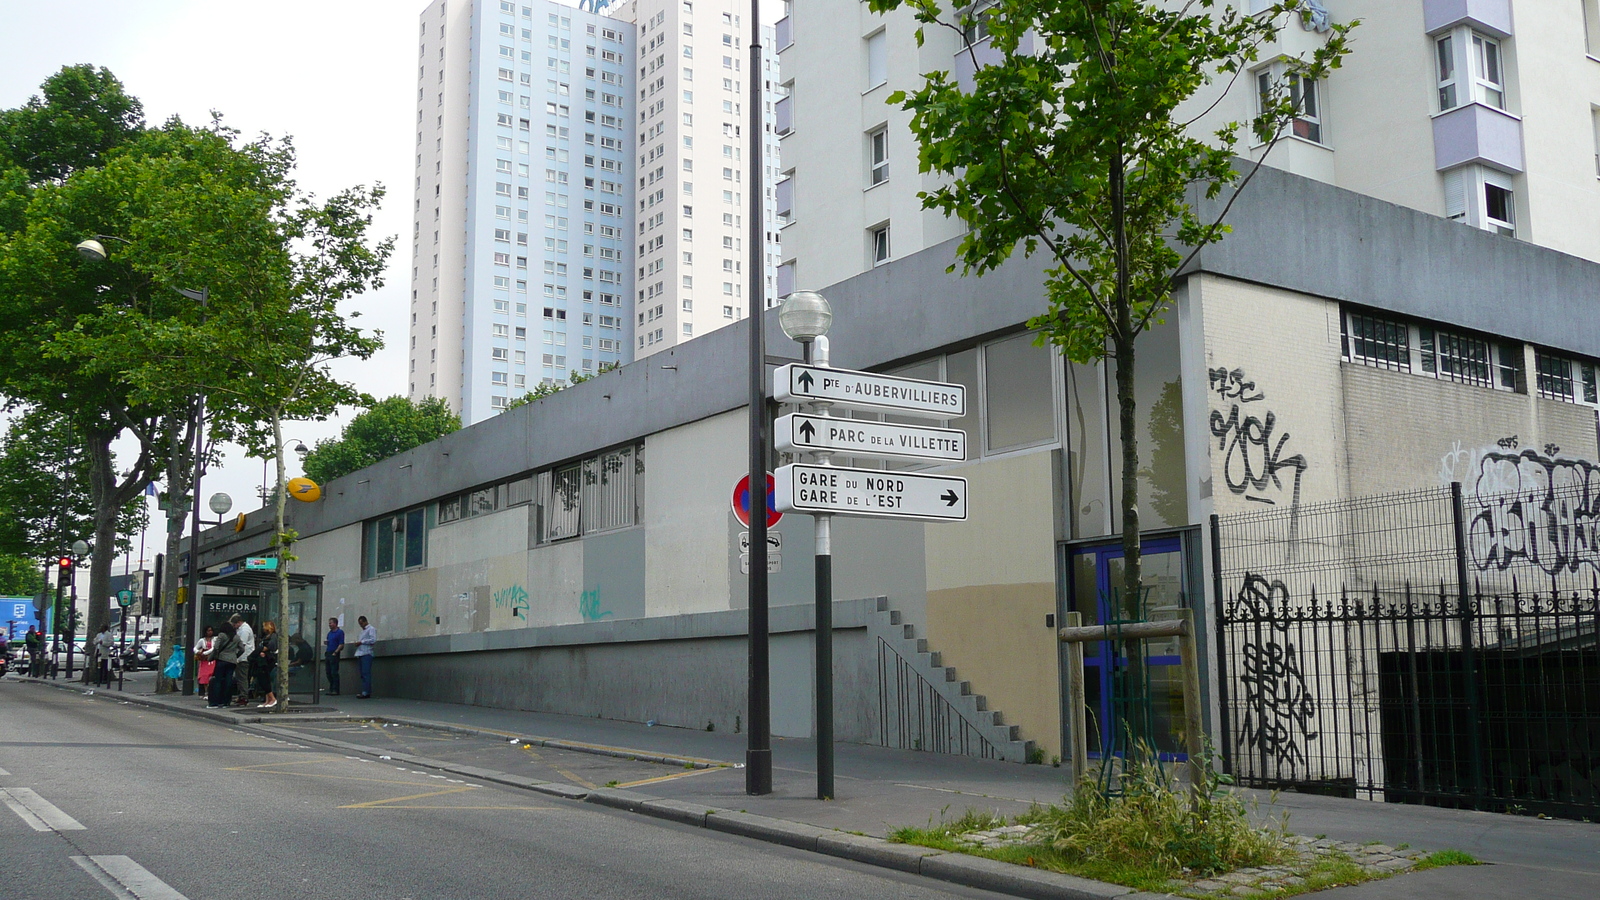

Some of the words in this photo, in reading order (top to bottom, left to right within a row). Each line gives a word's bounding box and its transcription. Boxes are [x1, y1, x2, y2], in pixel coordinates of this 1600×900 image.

[845, 382, 958, 406] D'AUBERVILLIERS
[830, 428, 865, 443] PARC
[871, 436, 882, 445] DE
[884, 437, 894, 446] LA
[899, 434, 959, 452] VILLETTE
[800, 472, 838, 487] GARE
[846, 480, 858, 489] DU
[866, 477, 904, 492] NORD
[800, 489, 838, 504] GARE
[847, 496, 858, 505] DE
[209, 602, 257, 611] SEPHORA
